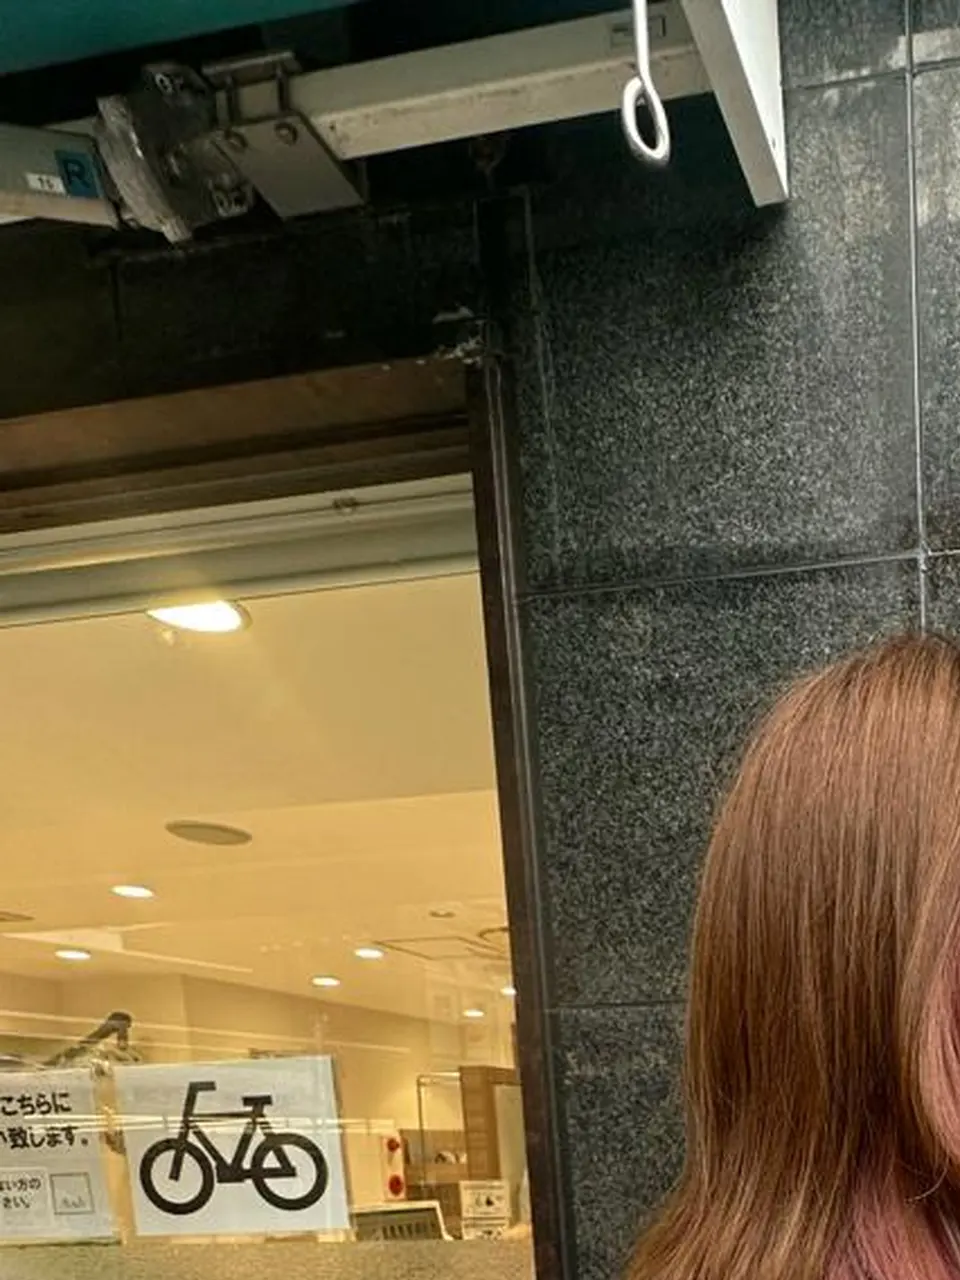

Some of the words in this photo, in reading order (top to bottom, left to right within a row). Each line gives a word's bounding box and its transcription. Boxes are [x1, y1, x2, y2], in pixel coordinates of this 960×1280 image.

[62, 159, 91, 189] R
[0, 1092, 72, 1116] こちらに
